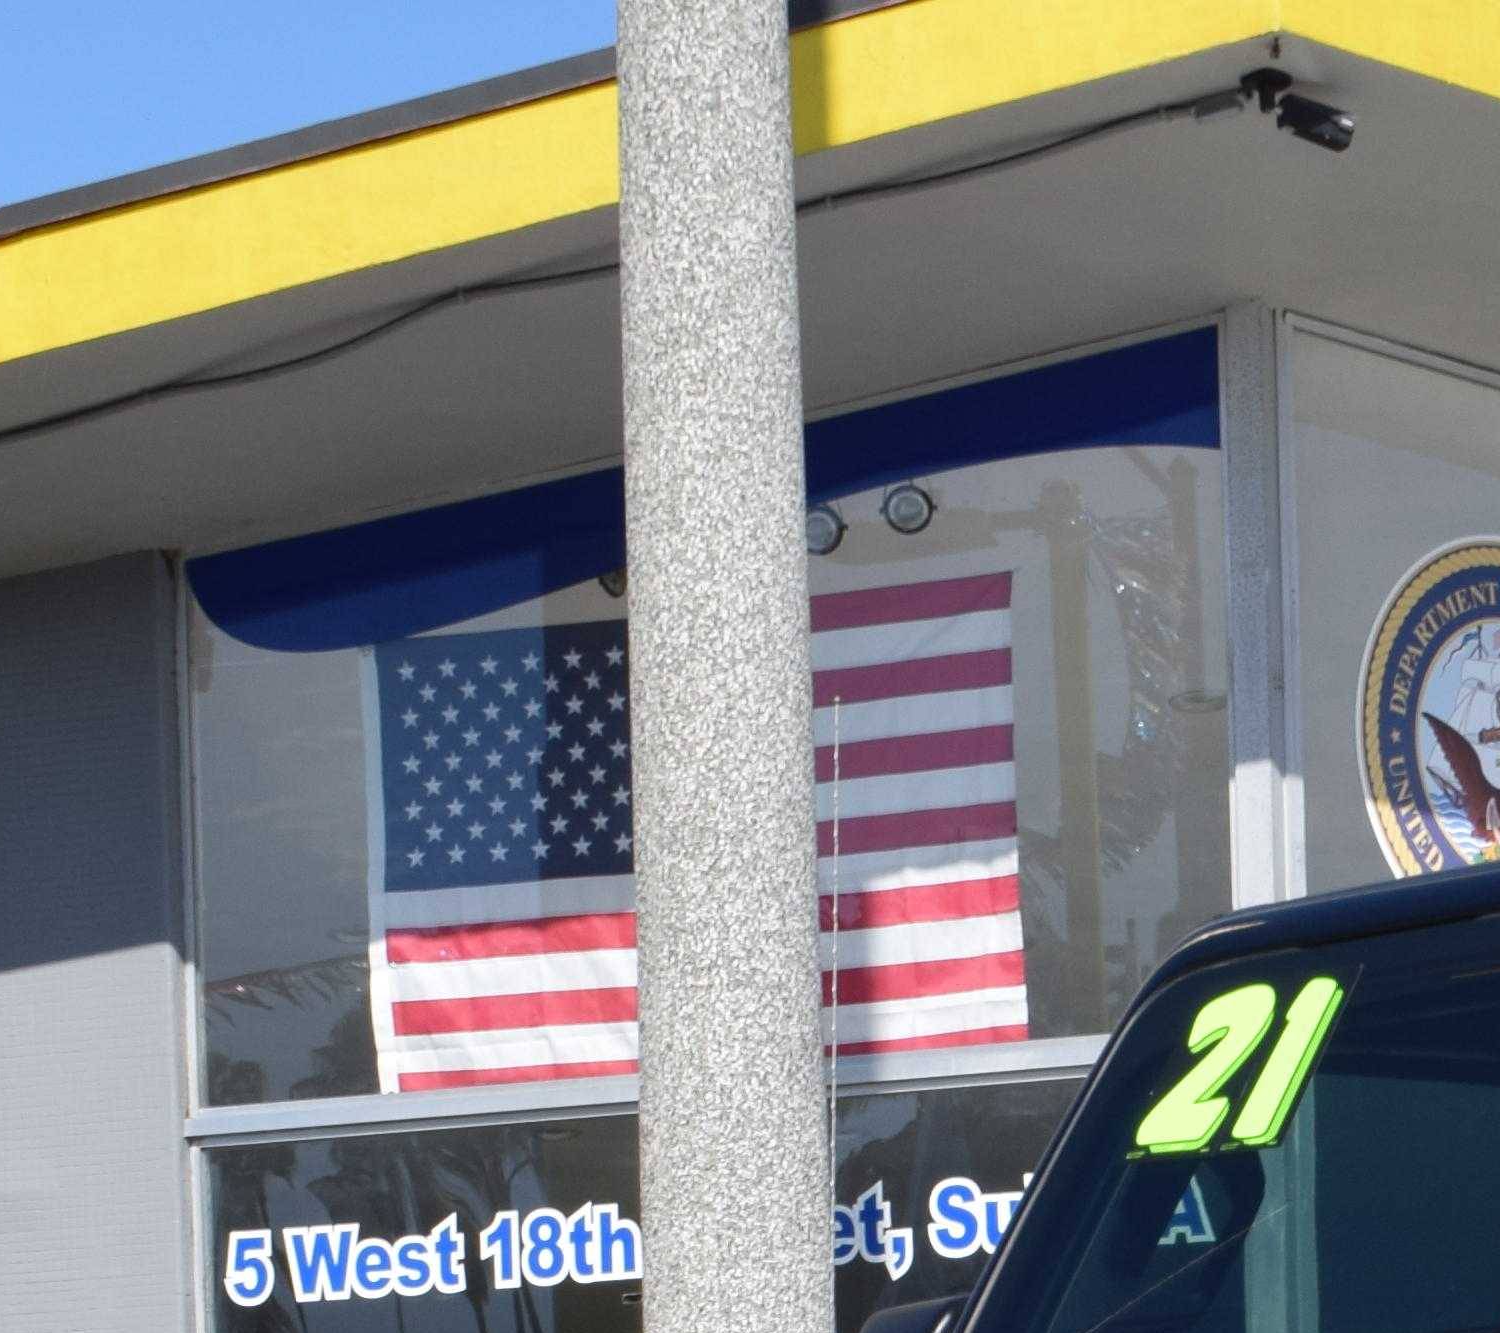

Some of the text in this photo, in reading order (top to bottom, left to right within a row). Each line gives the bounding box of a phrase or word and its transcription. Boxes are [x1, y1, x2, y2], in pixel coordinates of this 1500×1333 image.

[1390, 580, 1499, 716] DEPARTMENT
[1389, 756, 1445, 871] UNITED
[1133, 976, 1344, 1153] 21
[226, 1230, 274, 1305] 5
[283, 1213, 466, 1303] West
[480, 1202, 643, 1290] 18th
[833, 1180, 914, 1282] et,
[928, 1172, 1034, 1259] Su
